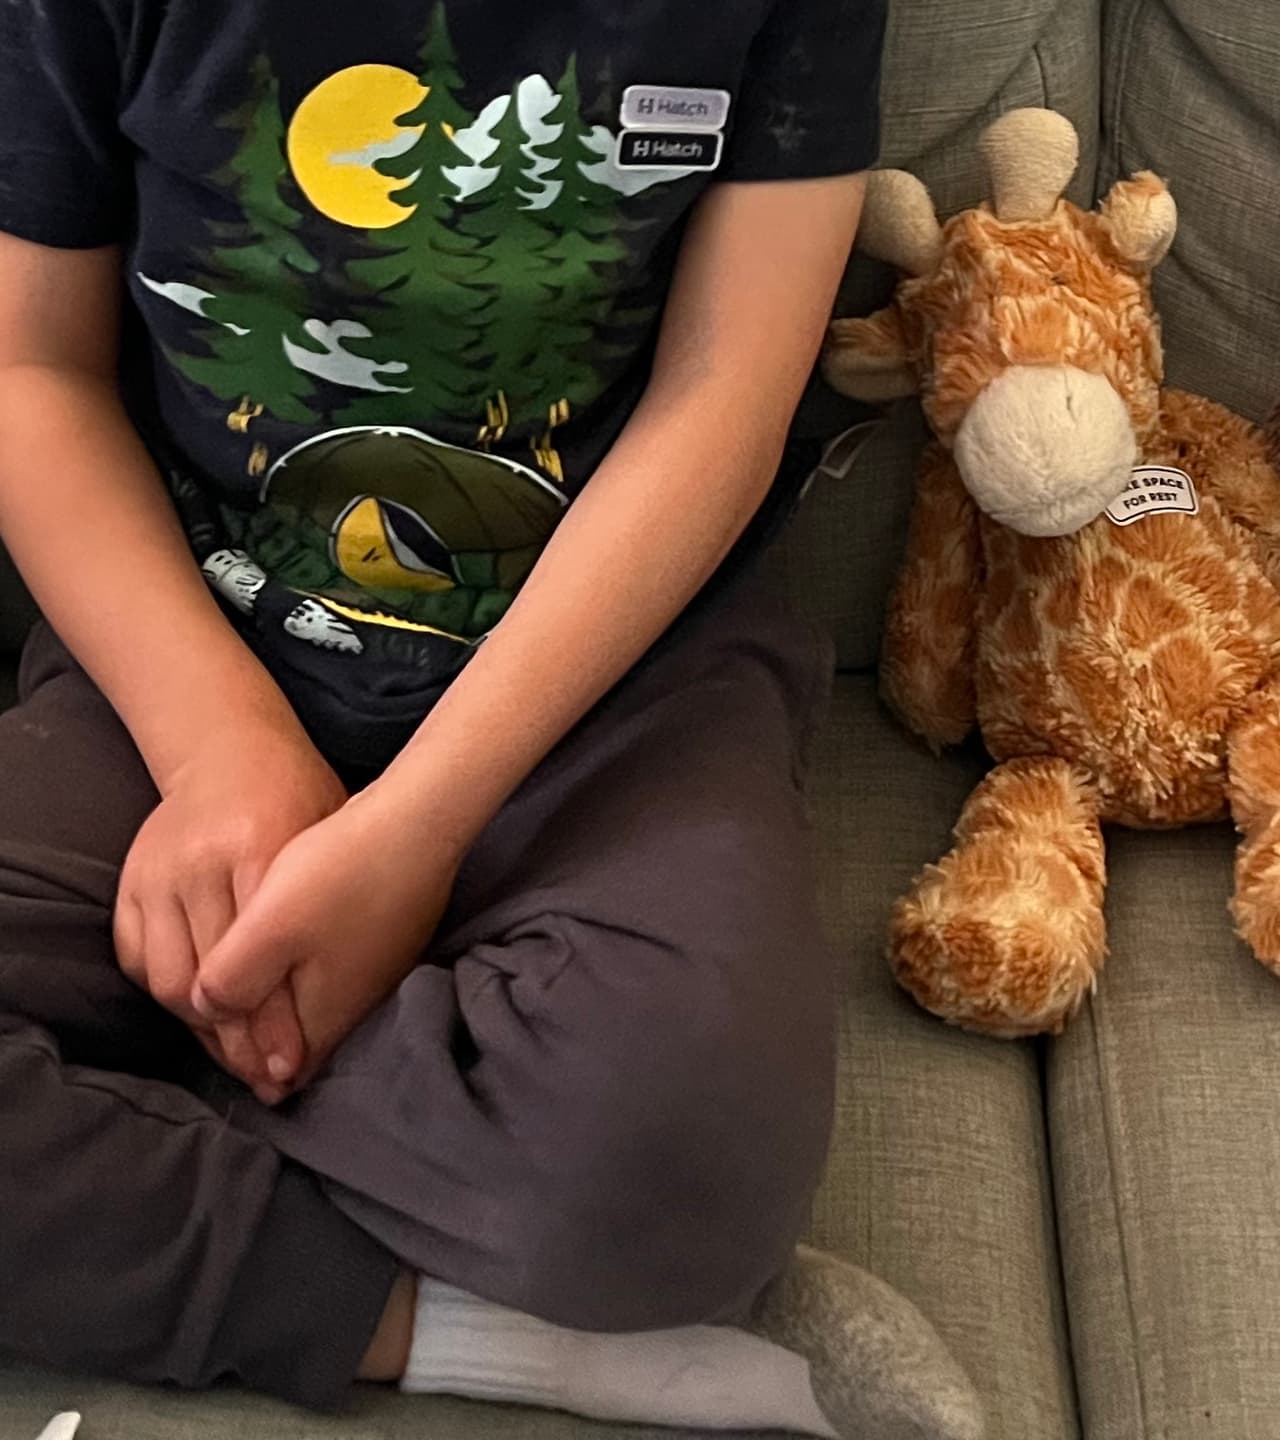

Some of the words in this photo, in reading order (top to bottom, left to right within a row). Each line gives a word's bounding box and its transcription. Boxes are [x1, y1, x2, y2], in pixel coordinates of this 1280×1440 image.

[658, 100, 708, 116] Hatch
[651, 140, 703, 158] Hatch
[1143, 478, 1184, 489] SPACE
[1123, 495, 1146, 508] FOR
[1149, 492, 1177, 501] REST
